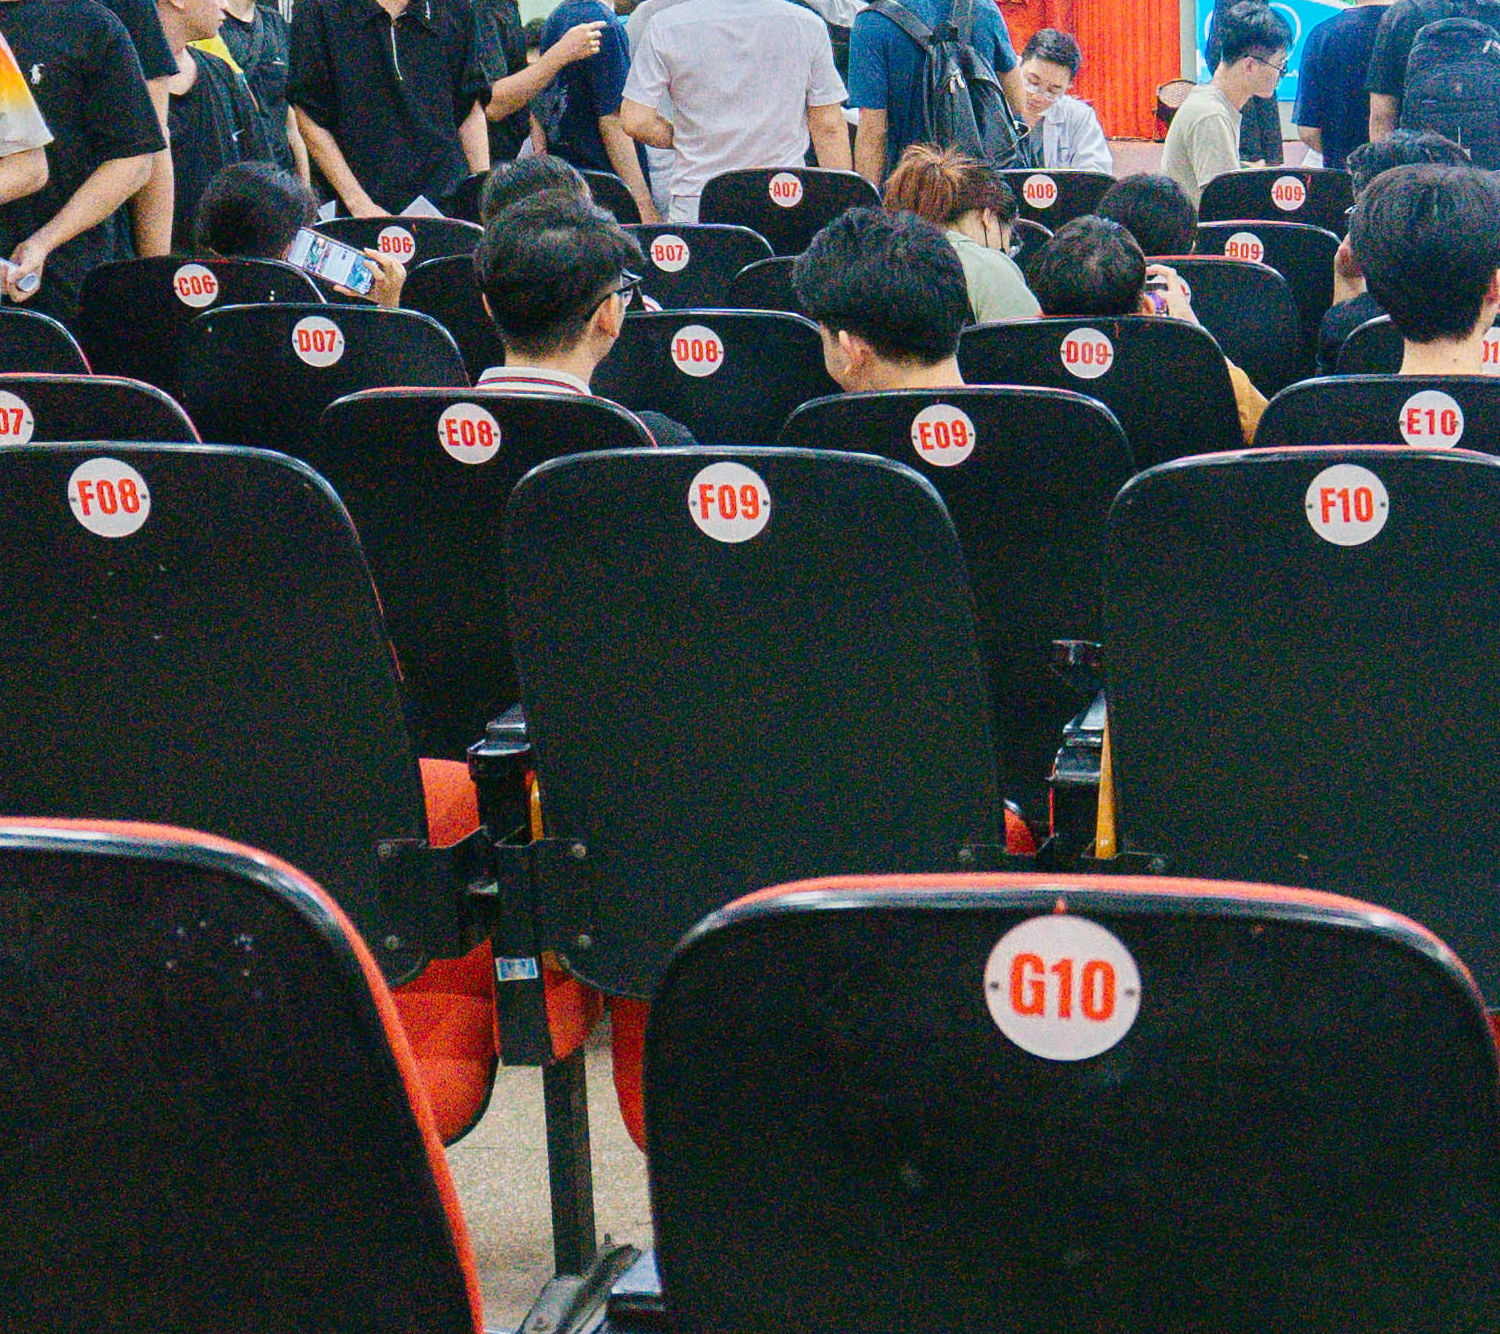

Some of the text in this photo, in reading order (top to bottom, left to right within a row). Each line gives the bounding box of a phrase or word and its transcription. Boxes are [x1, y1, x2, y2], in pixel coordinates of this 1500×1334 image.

[774, 182, 798, 197] A07
[1027, 184, 1054, 198] A08
[1276, 186, 1302, 201] A09
[382, 236, 412, 253] B06
[655, 245, 683, 261] B07
[1229, 242, 1259, 261] B09
[178, 275, 214, 296] C06
[298, 329, 336, 352] D07
[676, 339, 718, 362] D08
[1066, 341, 1108, 364] D09
[445, 419, 493, 447] E08
[1407, 408, 1456, 436] E10
[919, 420, 968, 450] E09
[77, 479, 140, 515] F08
[699, 484, 760, 520] F09
[1321, 487, 1374, 523] F10
[1010, 953, 1116, 1022] G10
